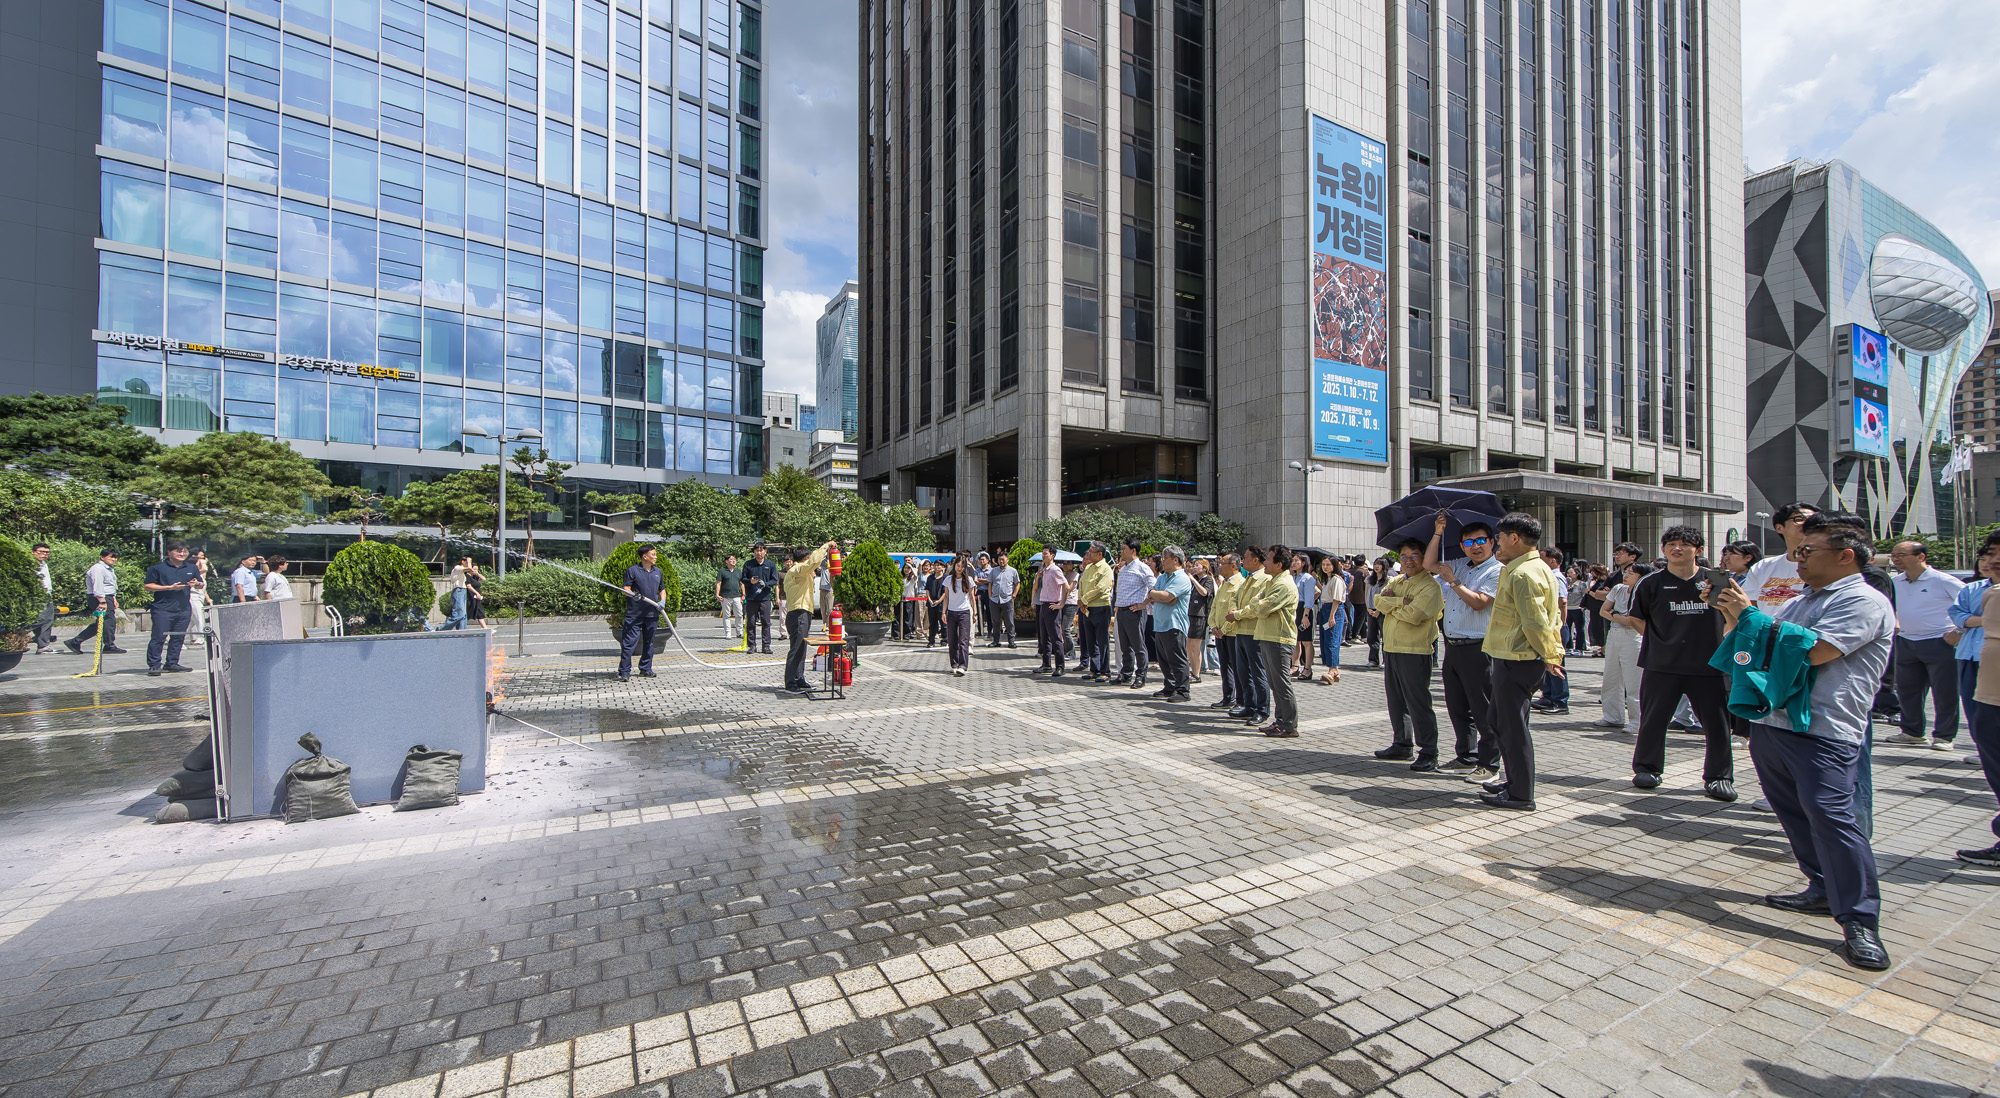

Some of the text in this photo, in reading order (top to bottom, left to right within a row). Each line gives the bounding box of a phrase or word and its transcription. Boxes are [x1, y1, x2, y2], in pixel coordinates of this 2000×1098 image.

[1316, 152, 1383, 216] 뉴욕의
[1316, 202, 1383, 264] 거장들
[188, 343, 214, 353] 피부과
[1322, 381, 1342, 396] 2025.
[1320, 410, 1340, 424] 2025.
